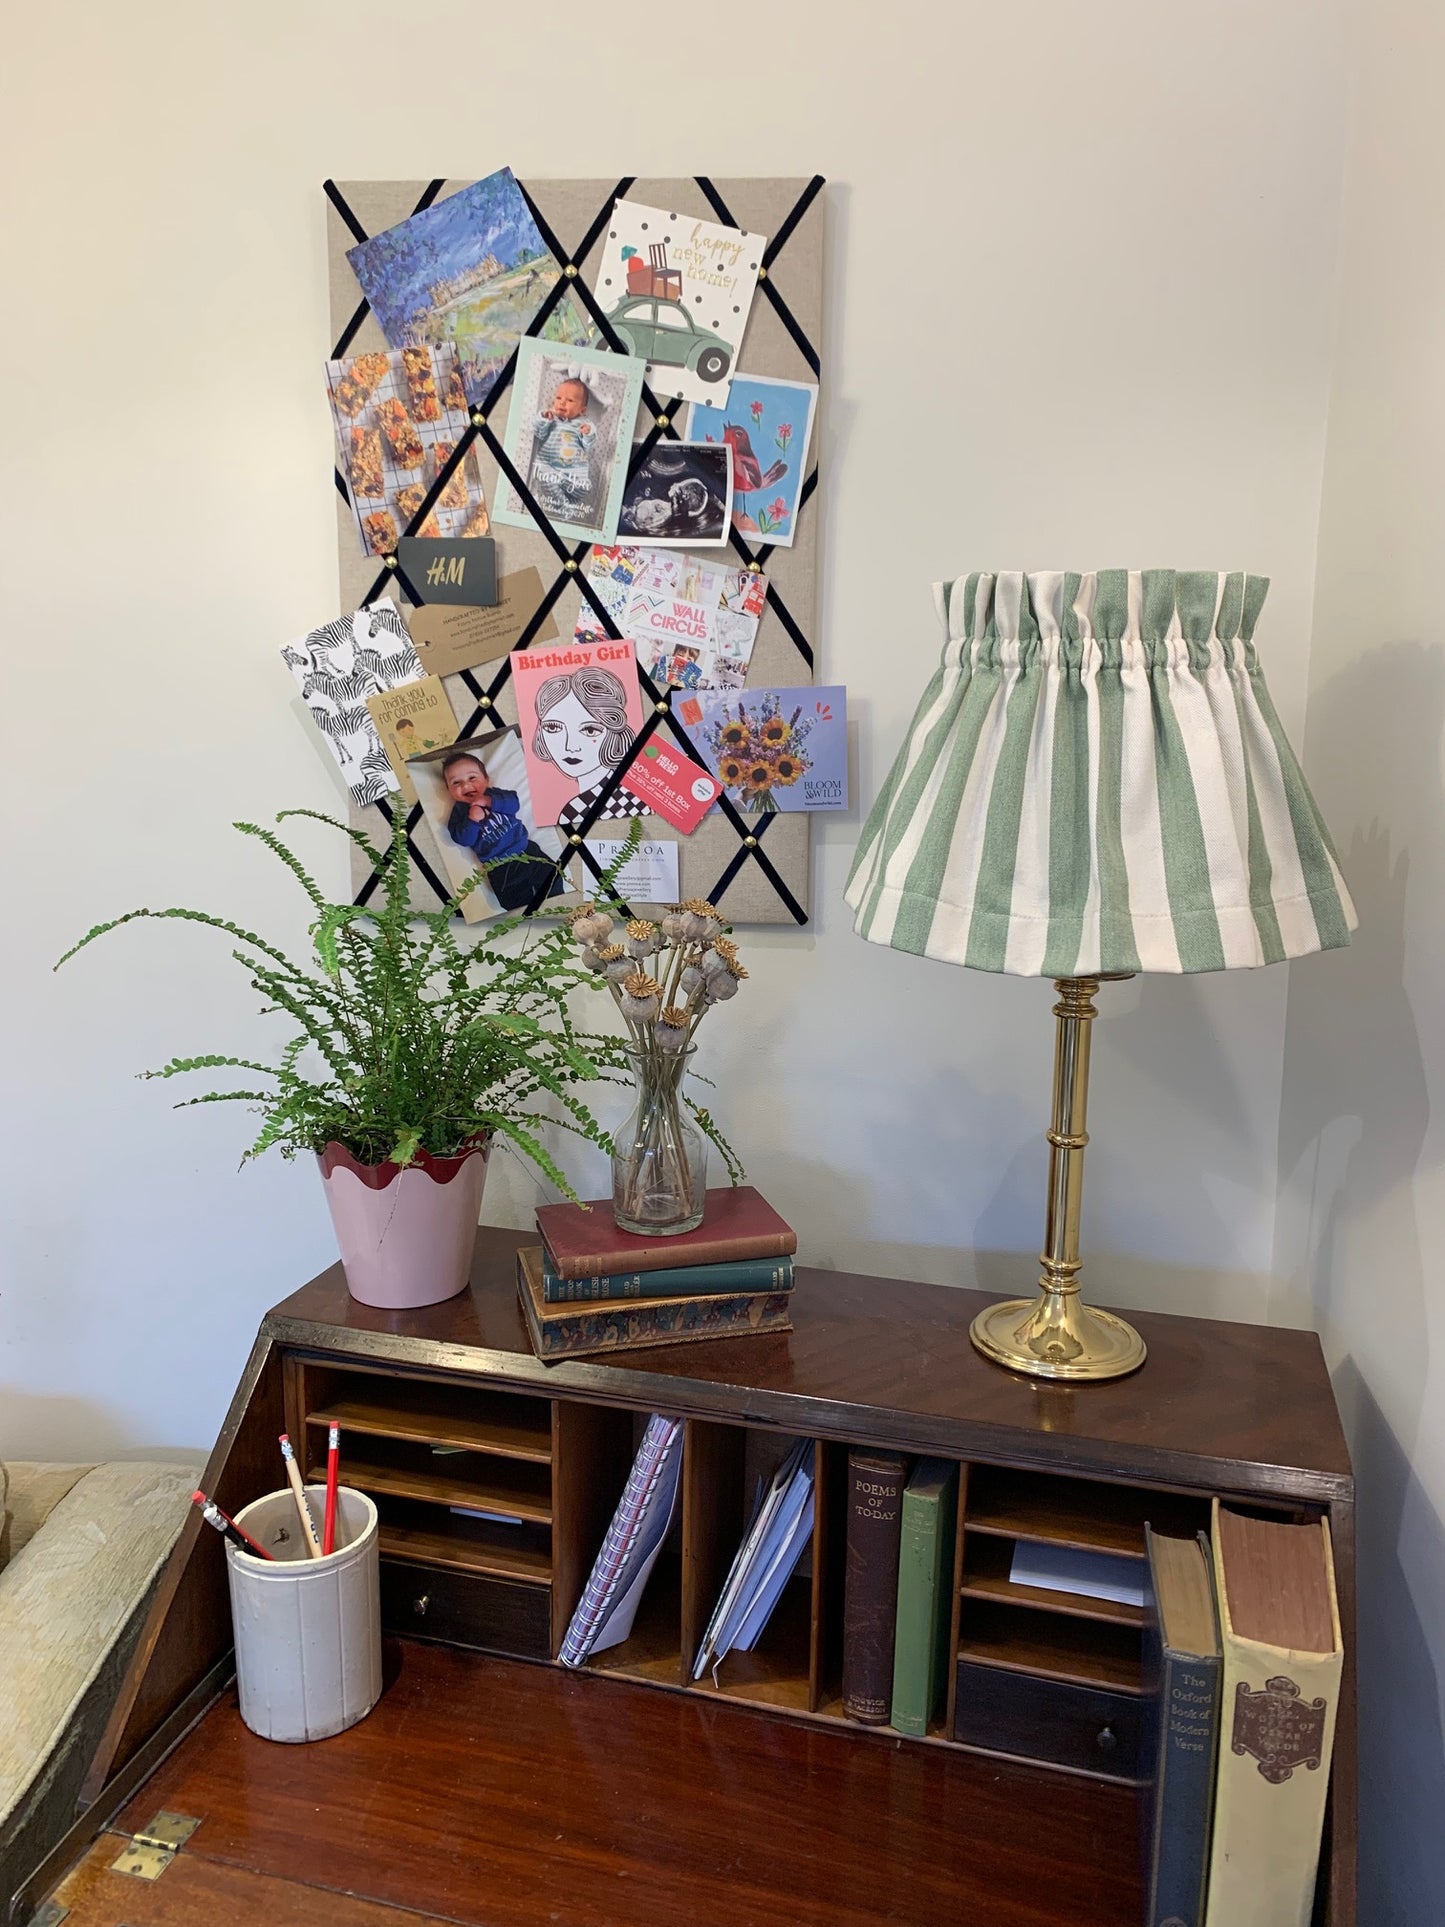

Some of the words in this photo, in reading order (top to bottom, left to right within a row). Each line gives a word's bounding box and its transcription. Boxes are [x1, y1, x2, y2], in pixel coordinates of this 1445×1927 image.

[690, 223, 745, 266] happy
[672, 246, 706, 264] new
[686, 262, 738, 298] home!
[532, 462, 564, 484] Thank
[566, 472, 592, 494] You
[426, 557, 466, 586] H&M
[672, 602, 705, 624] WALL
[650, 612, 706, 640] CIRCUS
[518, 652, 592, 670] Birthday
[596, 645, 630, 660] Girl
[382, 694, 407, 711] Thank
[407, 688, 425, 701] you
[378, 711, 393, 724] for
[394, 700, 426, 719] coming
[426, 695, 438, 708] to
[656, 758, 677, 776] FRESH
[658, 754, 679, 771] HELLO
[632, 761, 650, 778] 60%
[650, 776, 664, 790] off
[663, 786, 676, 799] 1st
[676, 794, 691, 810] Box
[804, 780, 841, 790] BLOOM
[856, 1480, 897, 1496] POEMS
[868, 1498, 883, 1507] OF
[856, 1506, 896, 1520] TO-DAY
[1182, 1674, 1206, 1687] The
[1172, 1688, 1212, 1703] Oxford
[1172, 1704, 1197, 1720] Book
[1199, 1710, 1212, 1720] of
[1170, 1720, 1210, 1736] Modern
[1175, 1736, 1204, 1751] Verse
